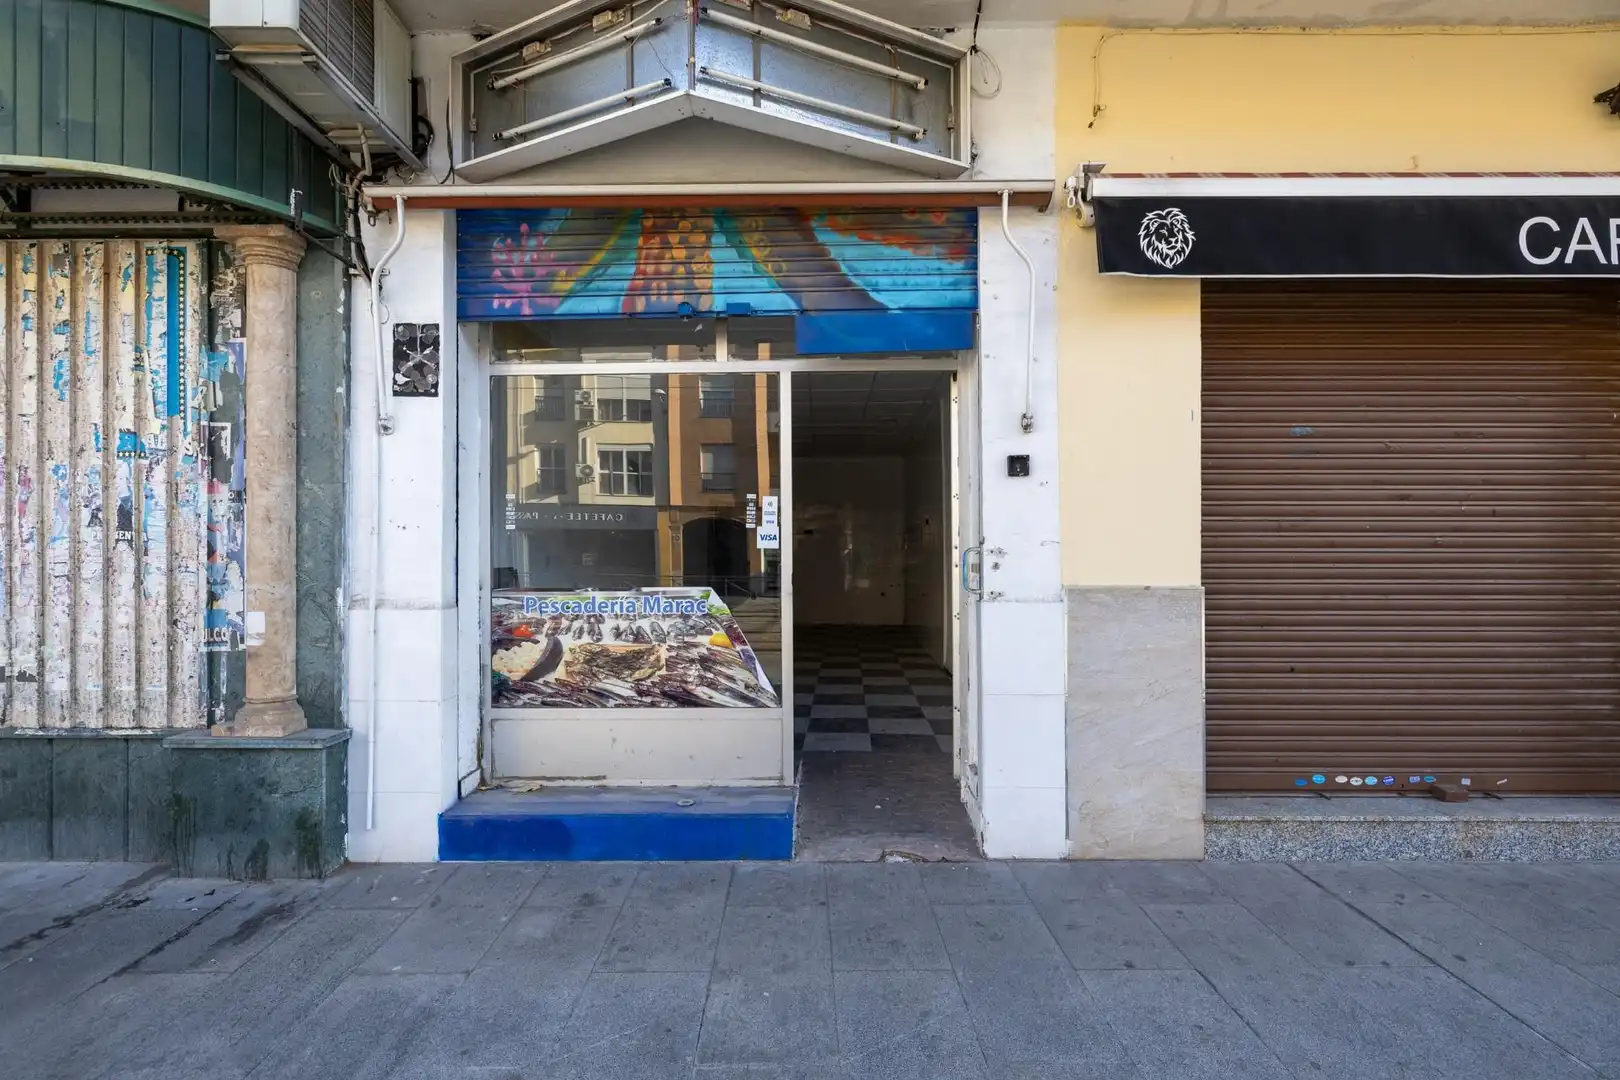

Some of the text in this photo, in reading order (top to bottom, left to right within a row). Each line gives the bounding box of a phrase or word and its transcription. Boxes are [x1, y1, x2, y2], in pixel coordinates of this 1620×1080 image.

[759, 533, 778, 542] VISA
[524, 595, 707, 617] Pescadería Marac
